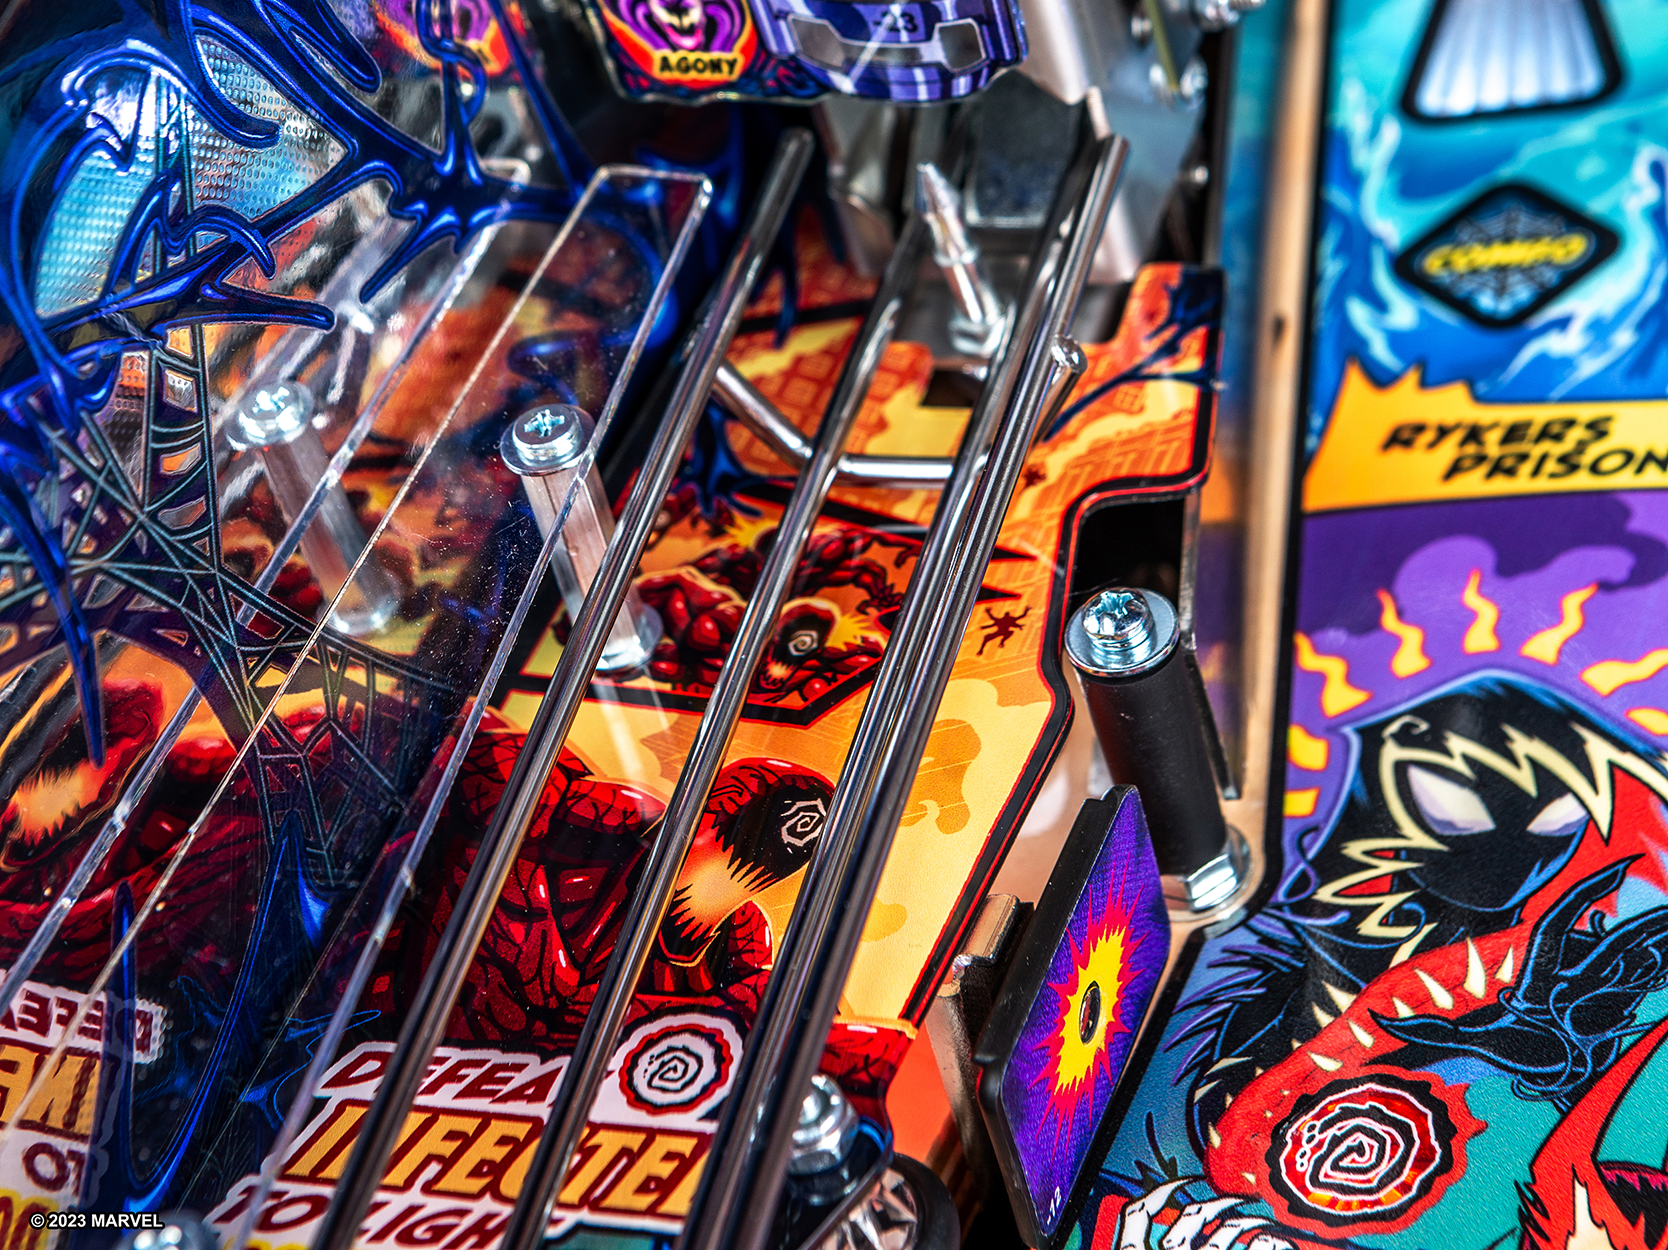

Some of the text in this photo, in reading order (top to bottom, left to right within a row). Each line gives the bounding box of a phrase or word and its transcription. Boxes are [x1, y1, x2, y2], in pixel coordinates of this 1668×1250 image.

[660, 55, 738, 76] AGONY
[1382, 416, 1614, 451] RYKERS
[1443, 449, 1668, 482] PRISON
[320, 1051, 617, 1107] DFEA
[212, 1185, 332, 1235] TO
[357, 1202, 564, 1250] IGH
